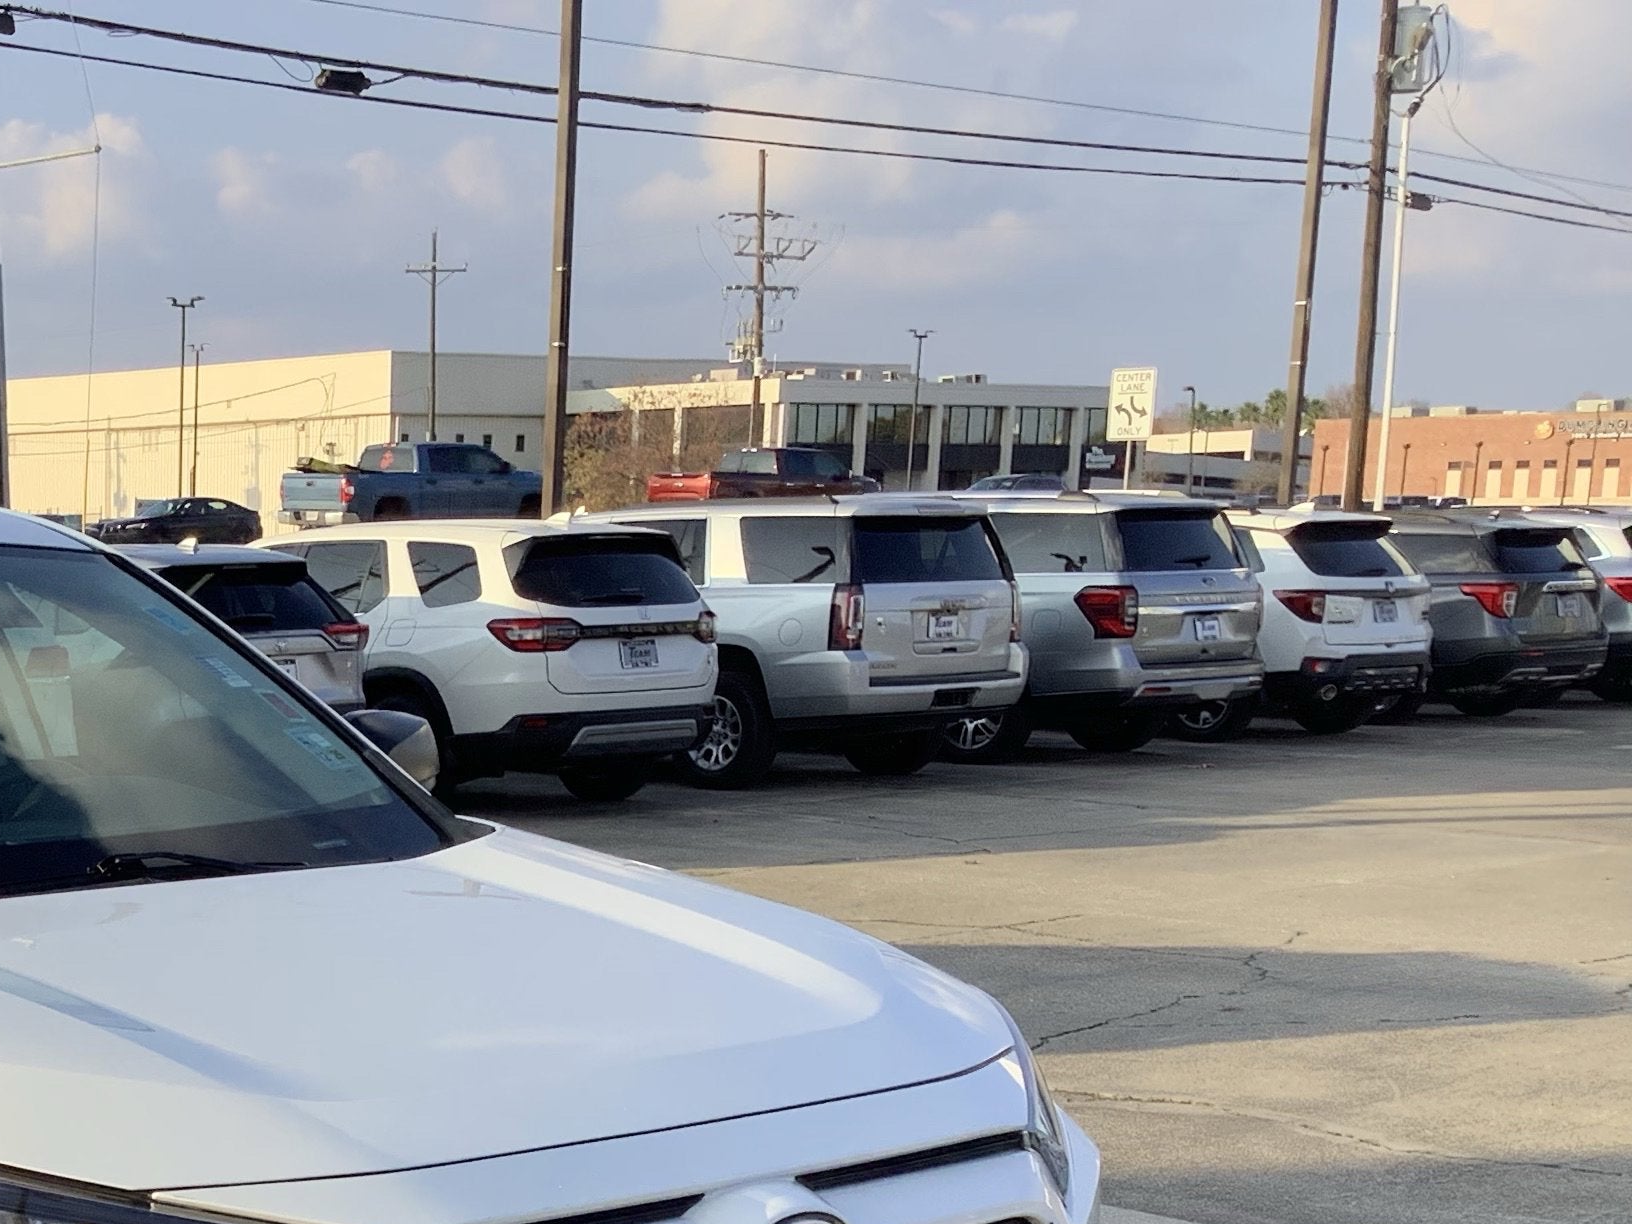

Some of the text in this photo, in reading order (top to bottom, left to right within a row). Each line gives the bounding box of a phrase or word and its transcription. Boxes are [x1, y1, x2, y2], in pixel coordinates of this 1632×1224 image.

[1116, 372, 1152, 383] CENTER
[1120, 382, 1146, 392] LANE
[1117, 426, 1143, 437] ONLY
